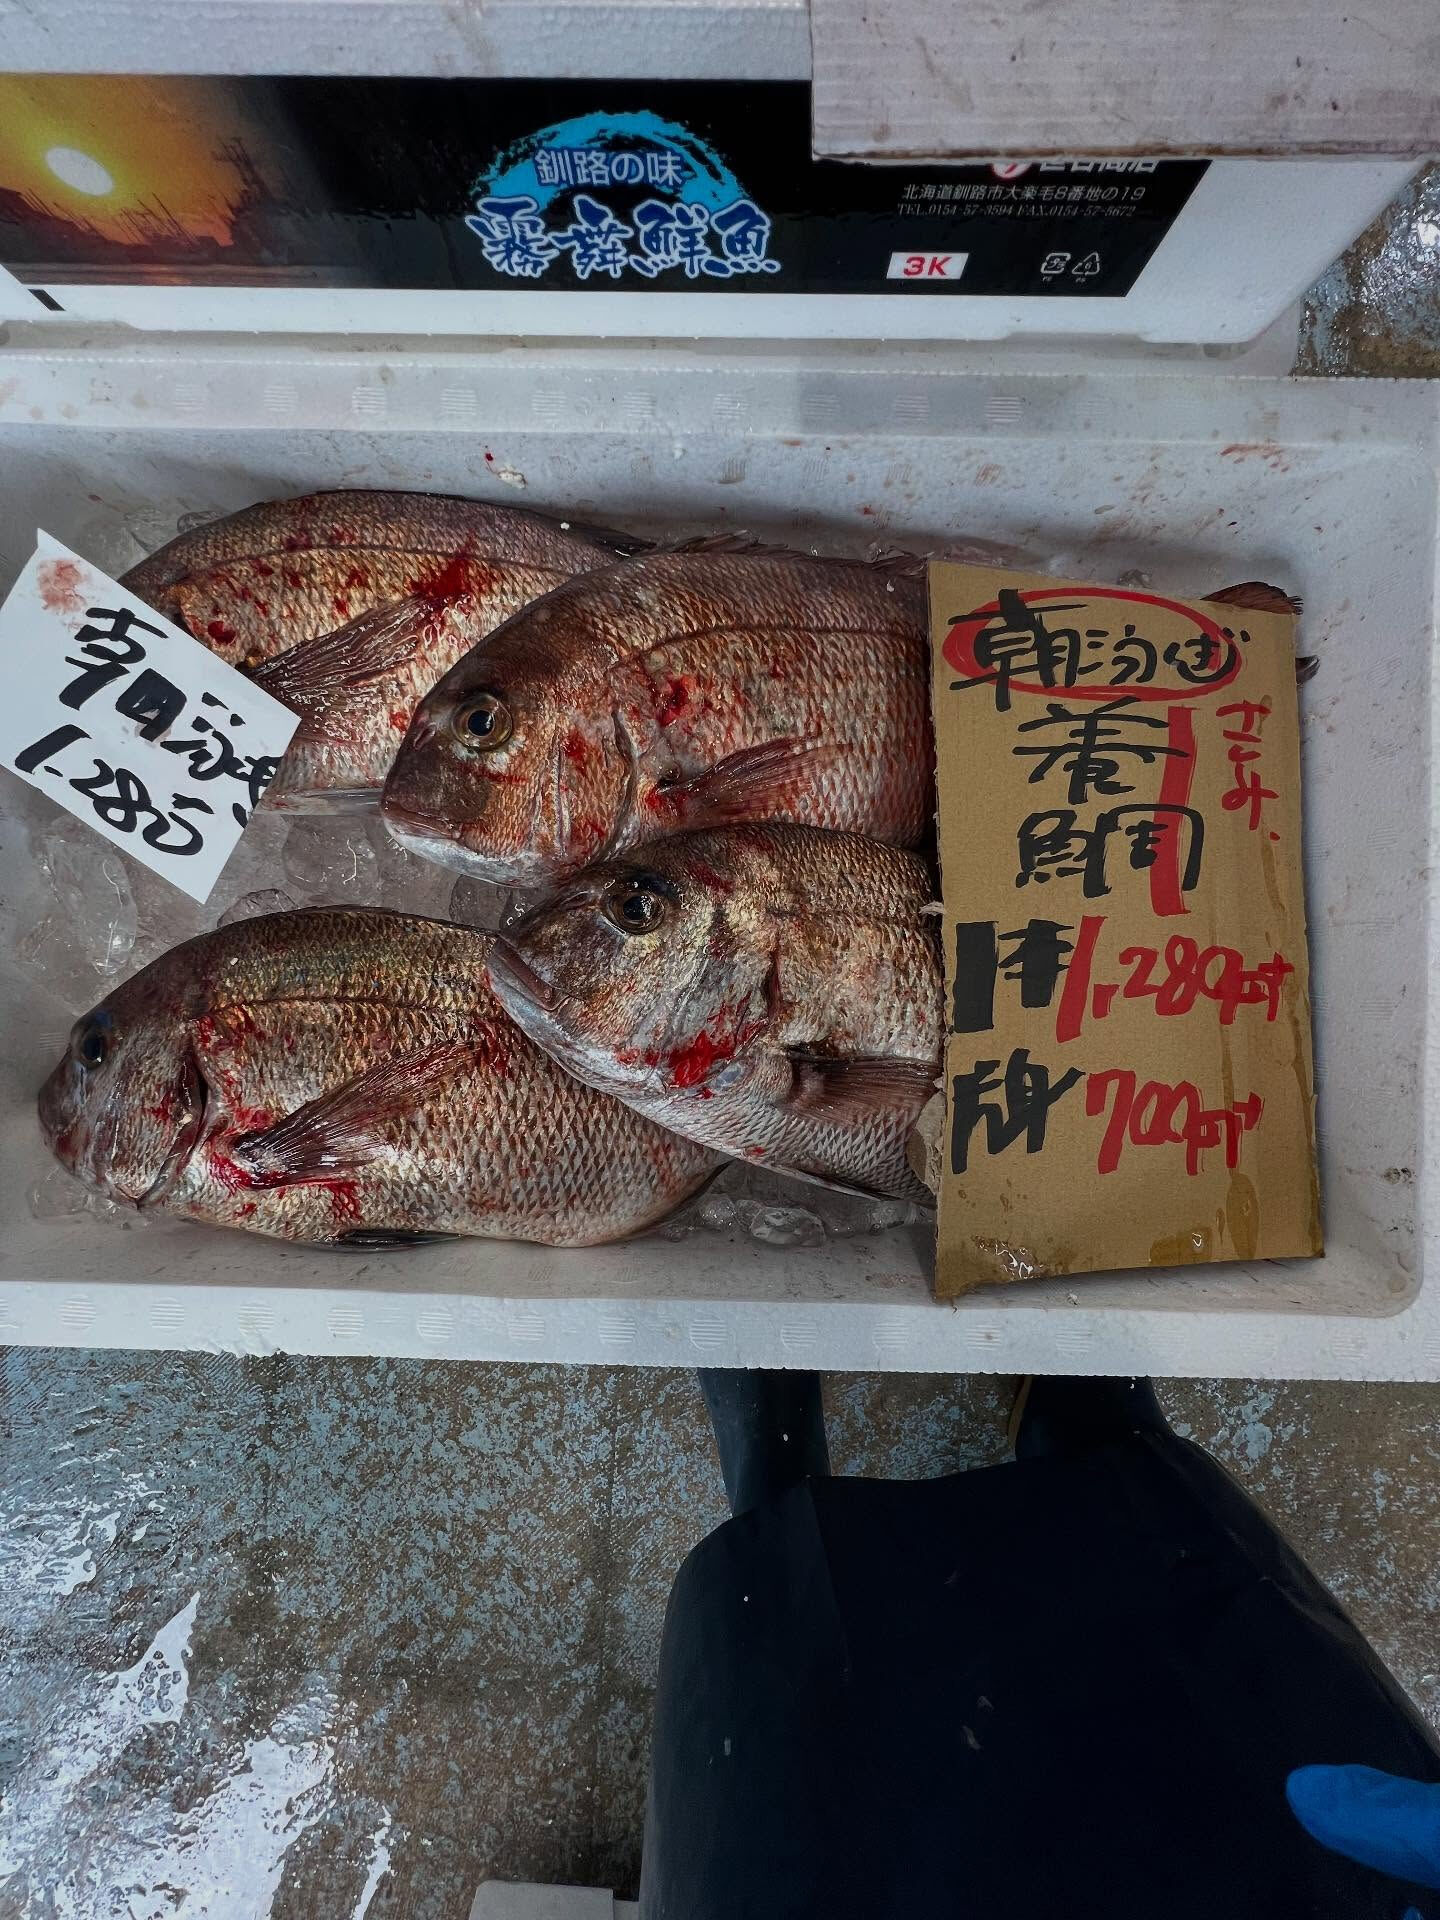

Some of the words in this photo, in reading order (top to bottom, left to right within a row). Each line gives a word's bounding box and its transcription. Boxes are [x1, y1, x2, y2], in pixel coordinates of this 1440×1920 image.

[535, 150, 684, 187] 釧路の味
[903, 256, 954, 277] 3K
